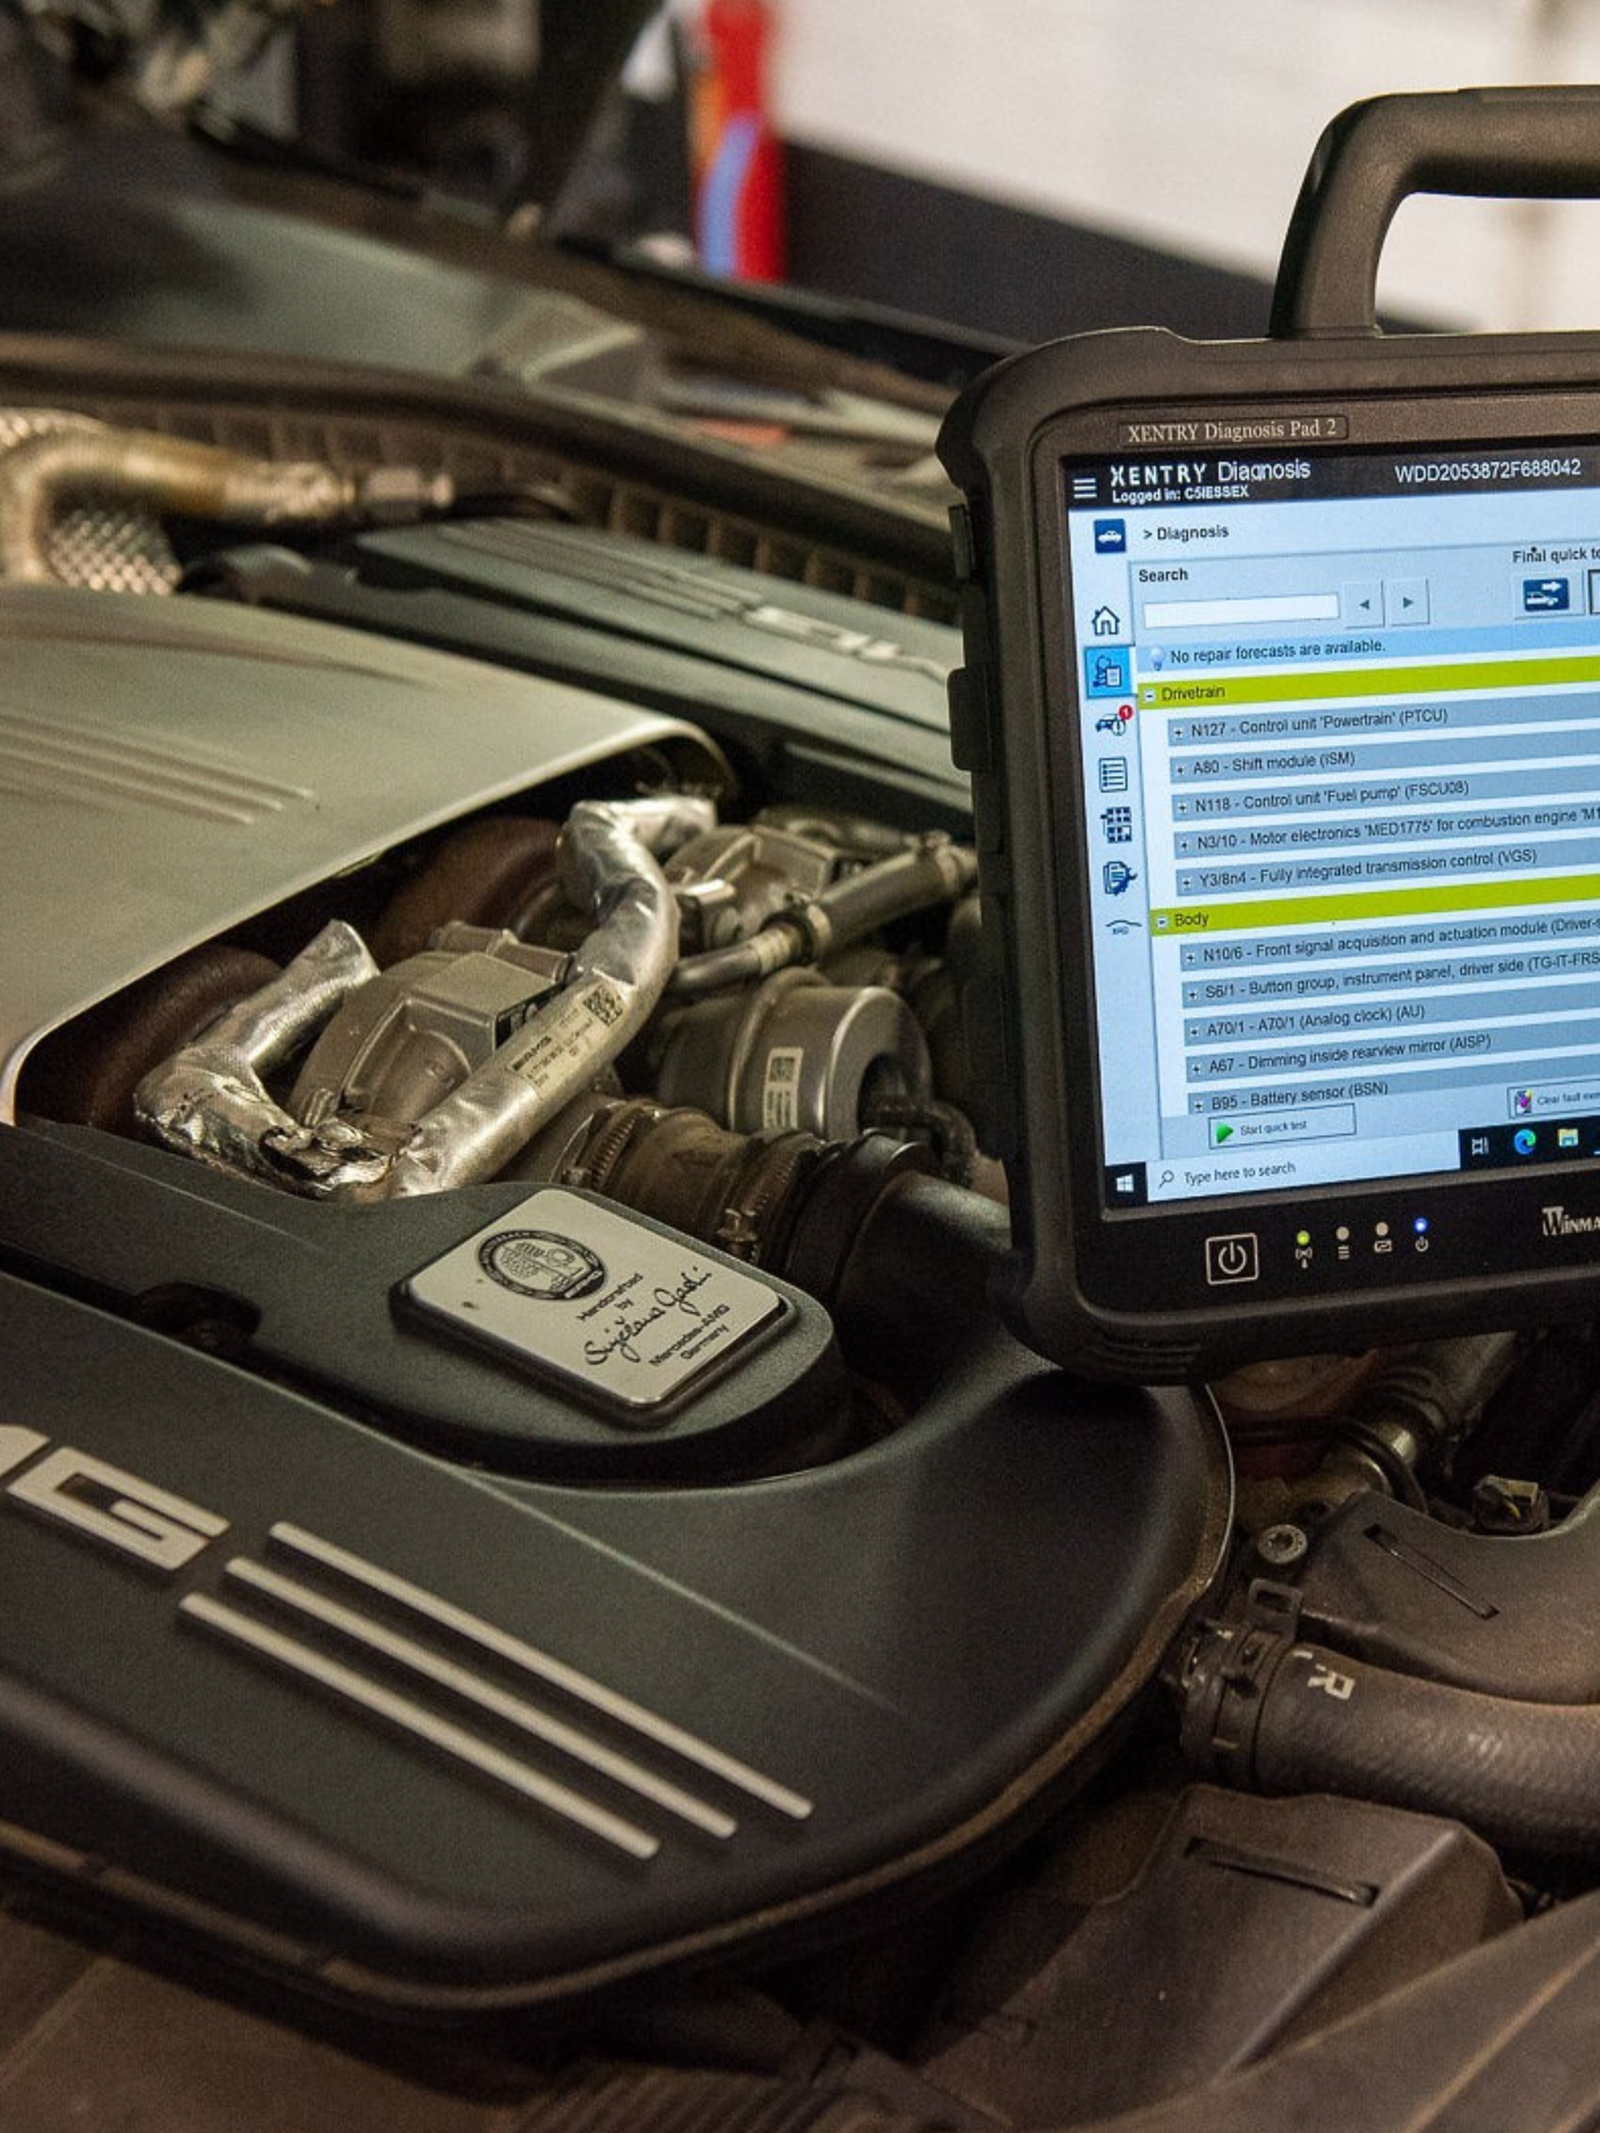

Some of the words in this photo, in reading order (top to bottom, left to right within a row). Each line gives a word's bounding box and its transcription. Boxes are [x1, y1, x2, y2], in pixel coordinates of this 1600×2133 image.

[1128, 423, 1199, 443] XENTRY
[1204, 420, 1285, 442] Diagnosis
[1290, 419, 1320, 437] Pad
[1327, 418, 1337, 435] 2
[1110, 463, 1207, 488] XENTRY
[1218, 458, 1311, 482] Diagnosis
[1112, 488, 1161, 505] Logged
[1164, 487, 1181, 501] in:
[1157, 524, 1229, 542] Diagnosis
[1512, 548, 1547, 563] Final
[1550, 547, 1588, 564] quick
[1138, 567, 1189, 583] Search
[1170, 649, 1189, 663] No
[1194, 647, 1230, 667] repair
[1235, 643, 1296, 661] forecasts
[1299, 643, 1321, 656] are
[1324, 639, 1386, 655] available.
[1161, 686, 1226, 701] Drivetrain
[1191, 723, 1226, 738] N127
[1240, 718, 1288, 735] Control
[1292, 716, 1317, 731] unit
[1399, 708, 1448, 726] (PTCU)
[1193, 762, 1219, 775] A80
[1232, 757, 1263, 772] Shift
[1267, 754, 1316, 770] module
[1319, 751, 1355, 768] (ISM)
[1195, 798, 1230, 812] N118
[1244, 794, 1292, 810] Control
[1296, 791, 1321, 806] unit
[1405, 780, 1469, 800] (FSCU08)
[1198, 835, 1237, 850] N3/10
[1250, 831, 1287, 846] Motor
[1291, 825, 1361, 843] electronics
[1437, 819, 1453, 832] for
[1457, 812, 1531, 831] combustion
[1534, 808, 1577, 826] engine
[1200, 871, 1246, 887] Y3/8n4
[1260, 867, 1292, 885] Fully
[1297, 862, 1363, 882] integrated
[1366, 857, 1447, 875] transmission
[1451, 851, 1494, 869] control
[1498, 849, 1537, 866] (VGS)
[1175, 912, 1209, 928] Body
[1204, 946, 1243, 962] N10/6
[1256, 943, 1291, 958] Front
[1295, 937, 1333, 957] signal
[1338, 933, 1406, 952] acquisition
[1410, 931, 1434, 945] and
[1439, 924, 1497, 942] actuation
[1500, 919, 1548, 937] module
[1206, 984, 1235, 999] S6/1
[1249, 980, 1292, 995] Button
[1297, 976, 1339, 994] group,
[1343, 968, 1412, 988] instrument
[1415, 965, 1455, 983] panel,
[1459, 960, 1494, 977] driver
[1498, 958, 1524, 974] side
[1207, 1021, 1244, 1036] A70/1
[1258, 1016, 1295, 1032] A70/1
[1300, 1012, 1350, 1030] (Analog
[1354, 1007, 1392, 1024] clock)
[1396, 1004, 1425, 1021] (AU)
[1209, 1058, 1234, 1074] A67
[1248, 1050, 1307, 1069] Dimming
[1310, 1047, 1349, 1064] inside
[1352, 1041, 1405, 1059] rearview
[1408, 1037, 1446, 1054] mirror
[1211, 1095, 1237, 1110] B95
[1251, 1090, 1297, 1108] Battery
[1301, 1085, 1344, 1102] sensor
[1349, 1080, 1388, 1100] (BSN)
[1240, 1124, 1263, 1136] Start
[1264, 1121, 1289, 1134] quick
[1291, 1119, 1307, 1131] test
[1185, 1171, 1212, 1187] Type
[1214, 1167, 1240, 1181] here
[1243, 1166, 1255, 1177] to
[1258, 1161, 1296, 1176] search
